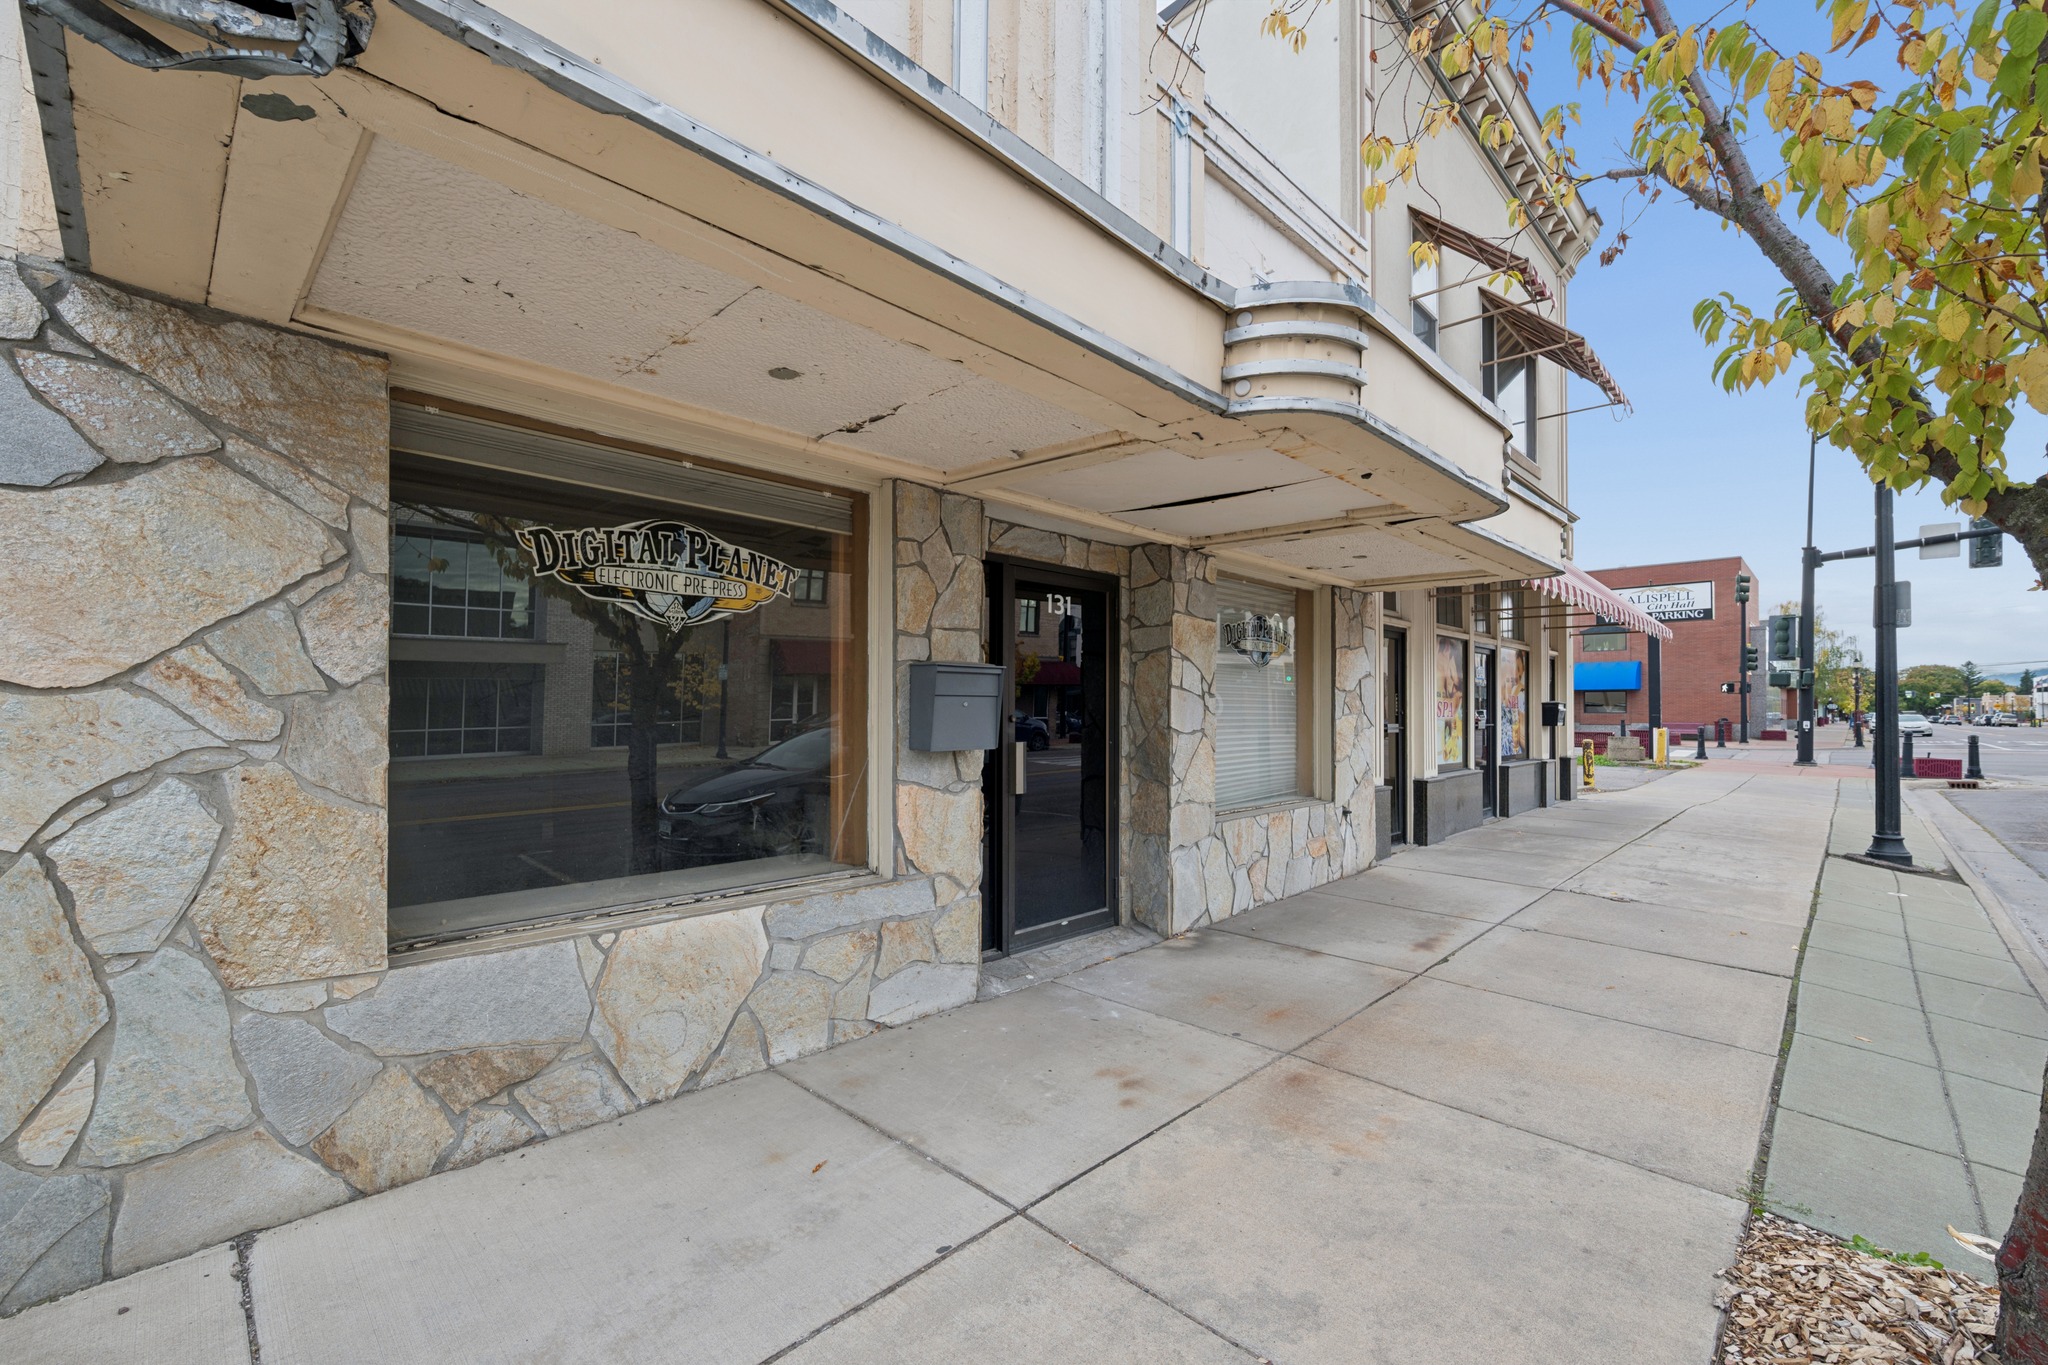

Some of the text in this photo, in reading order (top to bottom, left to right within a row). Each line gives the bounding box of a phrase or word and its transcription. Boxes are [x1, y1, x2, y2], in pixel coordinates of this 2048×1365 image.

[525, 527, 800, 598] DIGITAL PLANET
[598, 567, 744, 598] ELECTRONIC PRE-PRESS
[1046, 593, 1072, 616] 131
[1619, 591, 1695, 605] ALISPELL
[1647, 600, 1695, 612] City Hall
[1651, 609, 1704, 621] PARKING
[1437, 701, 1454, 718] SPA
